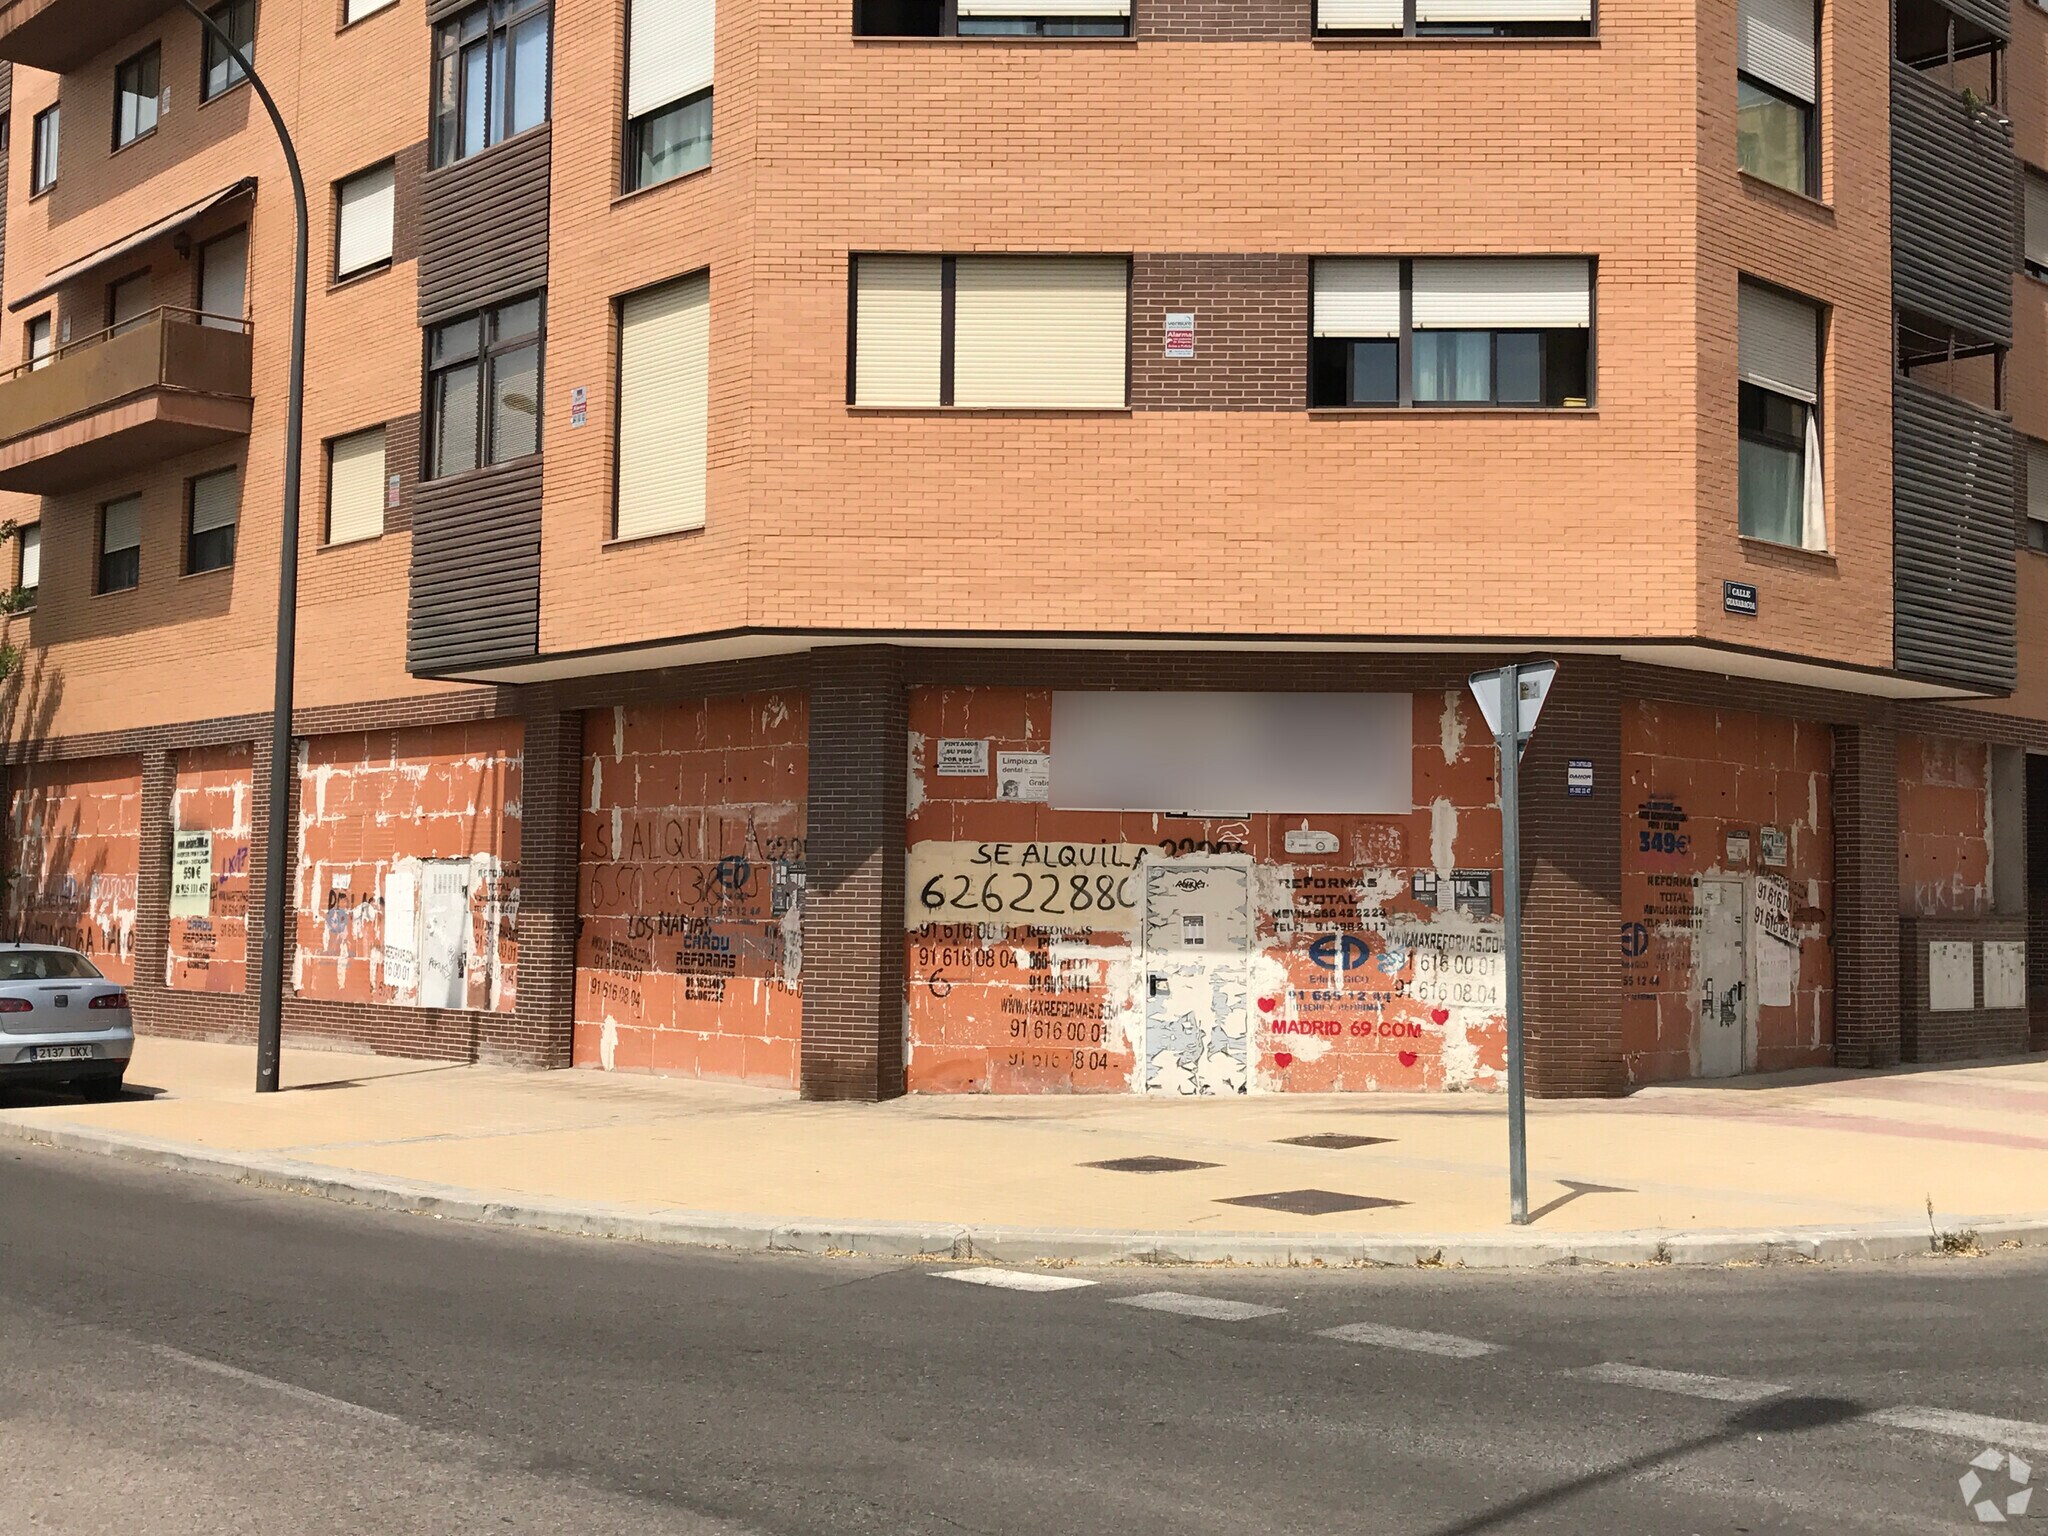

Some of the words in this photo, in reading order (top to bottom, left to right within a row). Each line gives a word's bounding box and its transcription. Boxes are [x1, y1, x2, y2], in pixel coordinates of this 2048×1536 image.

[1731, 587, 1751, 599] CALLE
[1002, 757, 1038, 767] Limpieza
[970, 844, 1013, 866] SE
[1021, 844, 1149, 870] ALQUILA
[1278, 877, 1378, 889] REFORMAS
[1301, 894, 1358, 905] TOTAL
[1659, 892, 1688, 903] TOTAL
[1757, 881, 1767, 900] 91
[1767, 887, 1782, 908] 616
[1754, 906, 1764, 925] 91
[627, 916, 654, 940] LOS
[683, 932, 730, 951] CARDU
[675, 951, 737, 969] REFORMAS
[919, 946, 936, 966] 91
[942, 947, 971, 967] 616
[976, 948, 995, 968] 08
[999, 949, 1018, 969] 04
[1420, 952, 1449, 973] 616
[1454, 955, 1473, 975] 00
[1478, 956, 1495, 976] 01
[1419, 981, 1448, 1001] 616
[1453, 983, 1473, 1003] 08
[1477, 984, 1497, 1004] 04
[1010, 1019, 1027, 1038] 91
[1034, 1020, 1062, 1040] 616
[1091, 1023, 1108, 1043] 01
[1271, 1020, 1342, 1036] MADRID
[39, 1047, 64, 1059] 2137
[70, 1046, 89, 1057] DKX
[1089, 1051, 1108, 1071] 04
